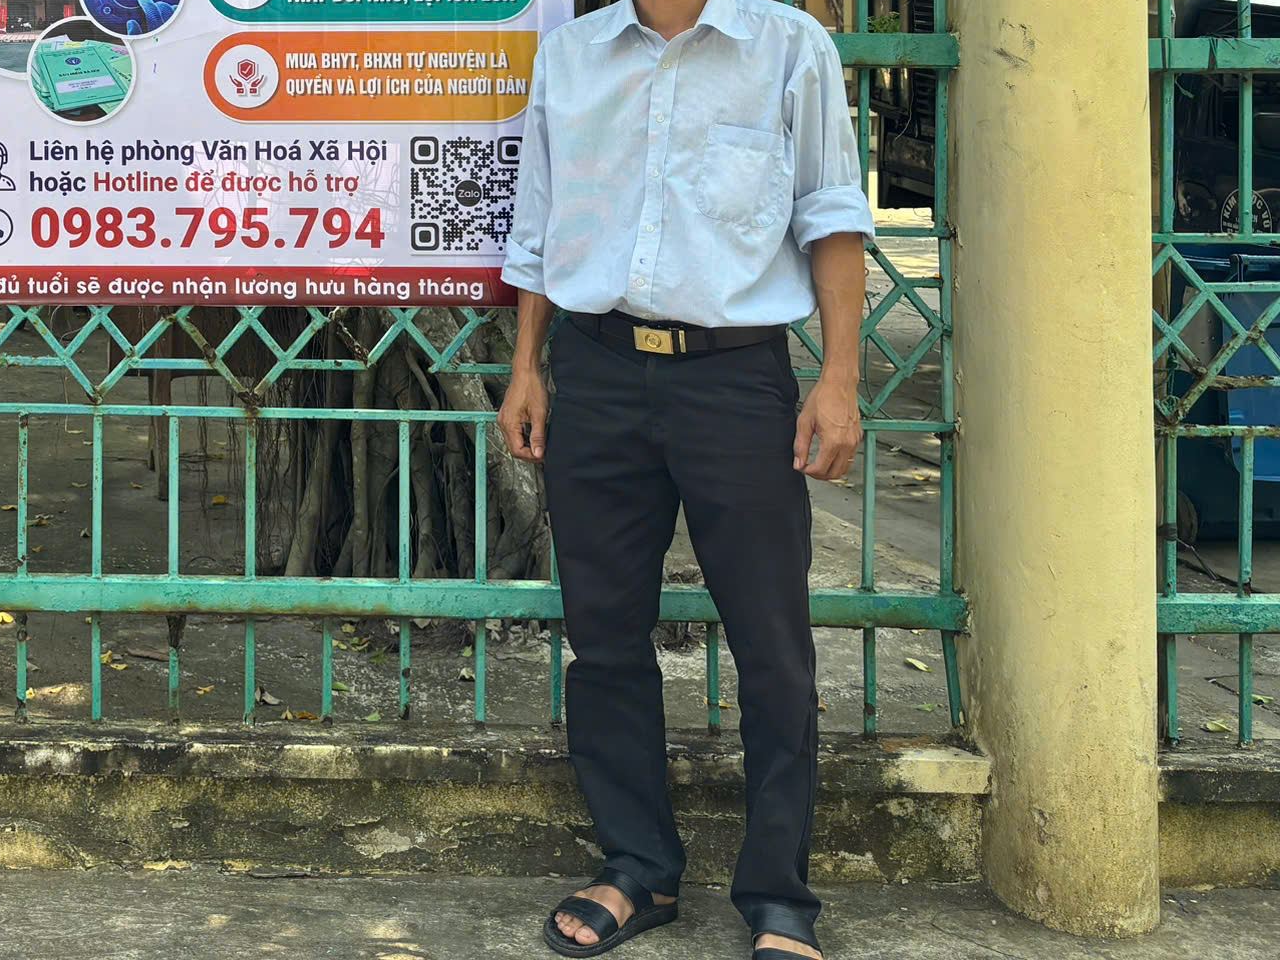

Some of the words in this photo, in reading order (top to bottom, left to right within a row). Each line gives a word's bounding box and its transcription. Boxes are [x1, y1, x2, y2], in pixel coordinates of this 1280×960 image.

[286, 54, 317, 69] MUA
[322, 53, 360, 71] BHYT,
[364, 53, 402, 69] BHXH
[406, 53, 425, 73] TỰ
[429, 52, 488, 72] NGUYỆN
[491, 50, 508, 68] LÀ
[286, 74, 332, 95] QUYỀN
[337, 76, 355, 94] VÀ
[360, 78, 382, 98] LỢI
[386, 77, 409, 94] ÍCH
[414, 74, 443, 94] CỦA
[448, 75, 492, 94] NGƯỜI
[497, 74, 528, 95] DÂN
[29, 141, 78, 161] Liên
[85, 141, 114, 165] hệ
[121, 140, 194, 167] phòng
[202, 141, 246, 161] Văn
[255, 140, 300, 161] Hoá
[308, 141, 338, 161] Xã
[347, 140, 387, 166] Hội
[29, 171, 86, 197] hoặc
[93, 172, 178, 192] Hotline
[184, 168, 214, 192] để
[222, 172, 281, 197] được
[288, 170, 318, 192] hỗ
[324, 174, 358, 197] trợ
[458, 189, 480, 198] Zalo
[1224, 195, 1237, 219] KIM
[31, 207, 385, 249] 0983.795.794
[28, 273, 68, 296] tuổi
[76, 276, 101, 296] sẽ
[109, 278, 164, 300] được
[172, 278, 227, 300] nhận
[235, 278, 297, 300] lương
[305, 278, 346, 297] hưu
[354, 278, 412, 300] hàng
[419, 277, 484, 301] tháng
